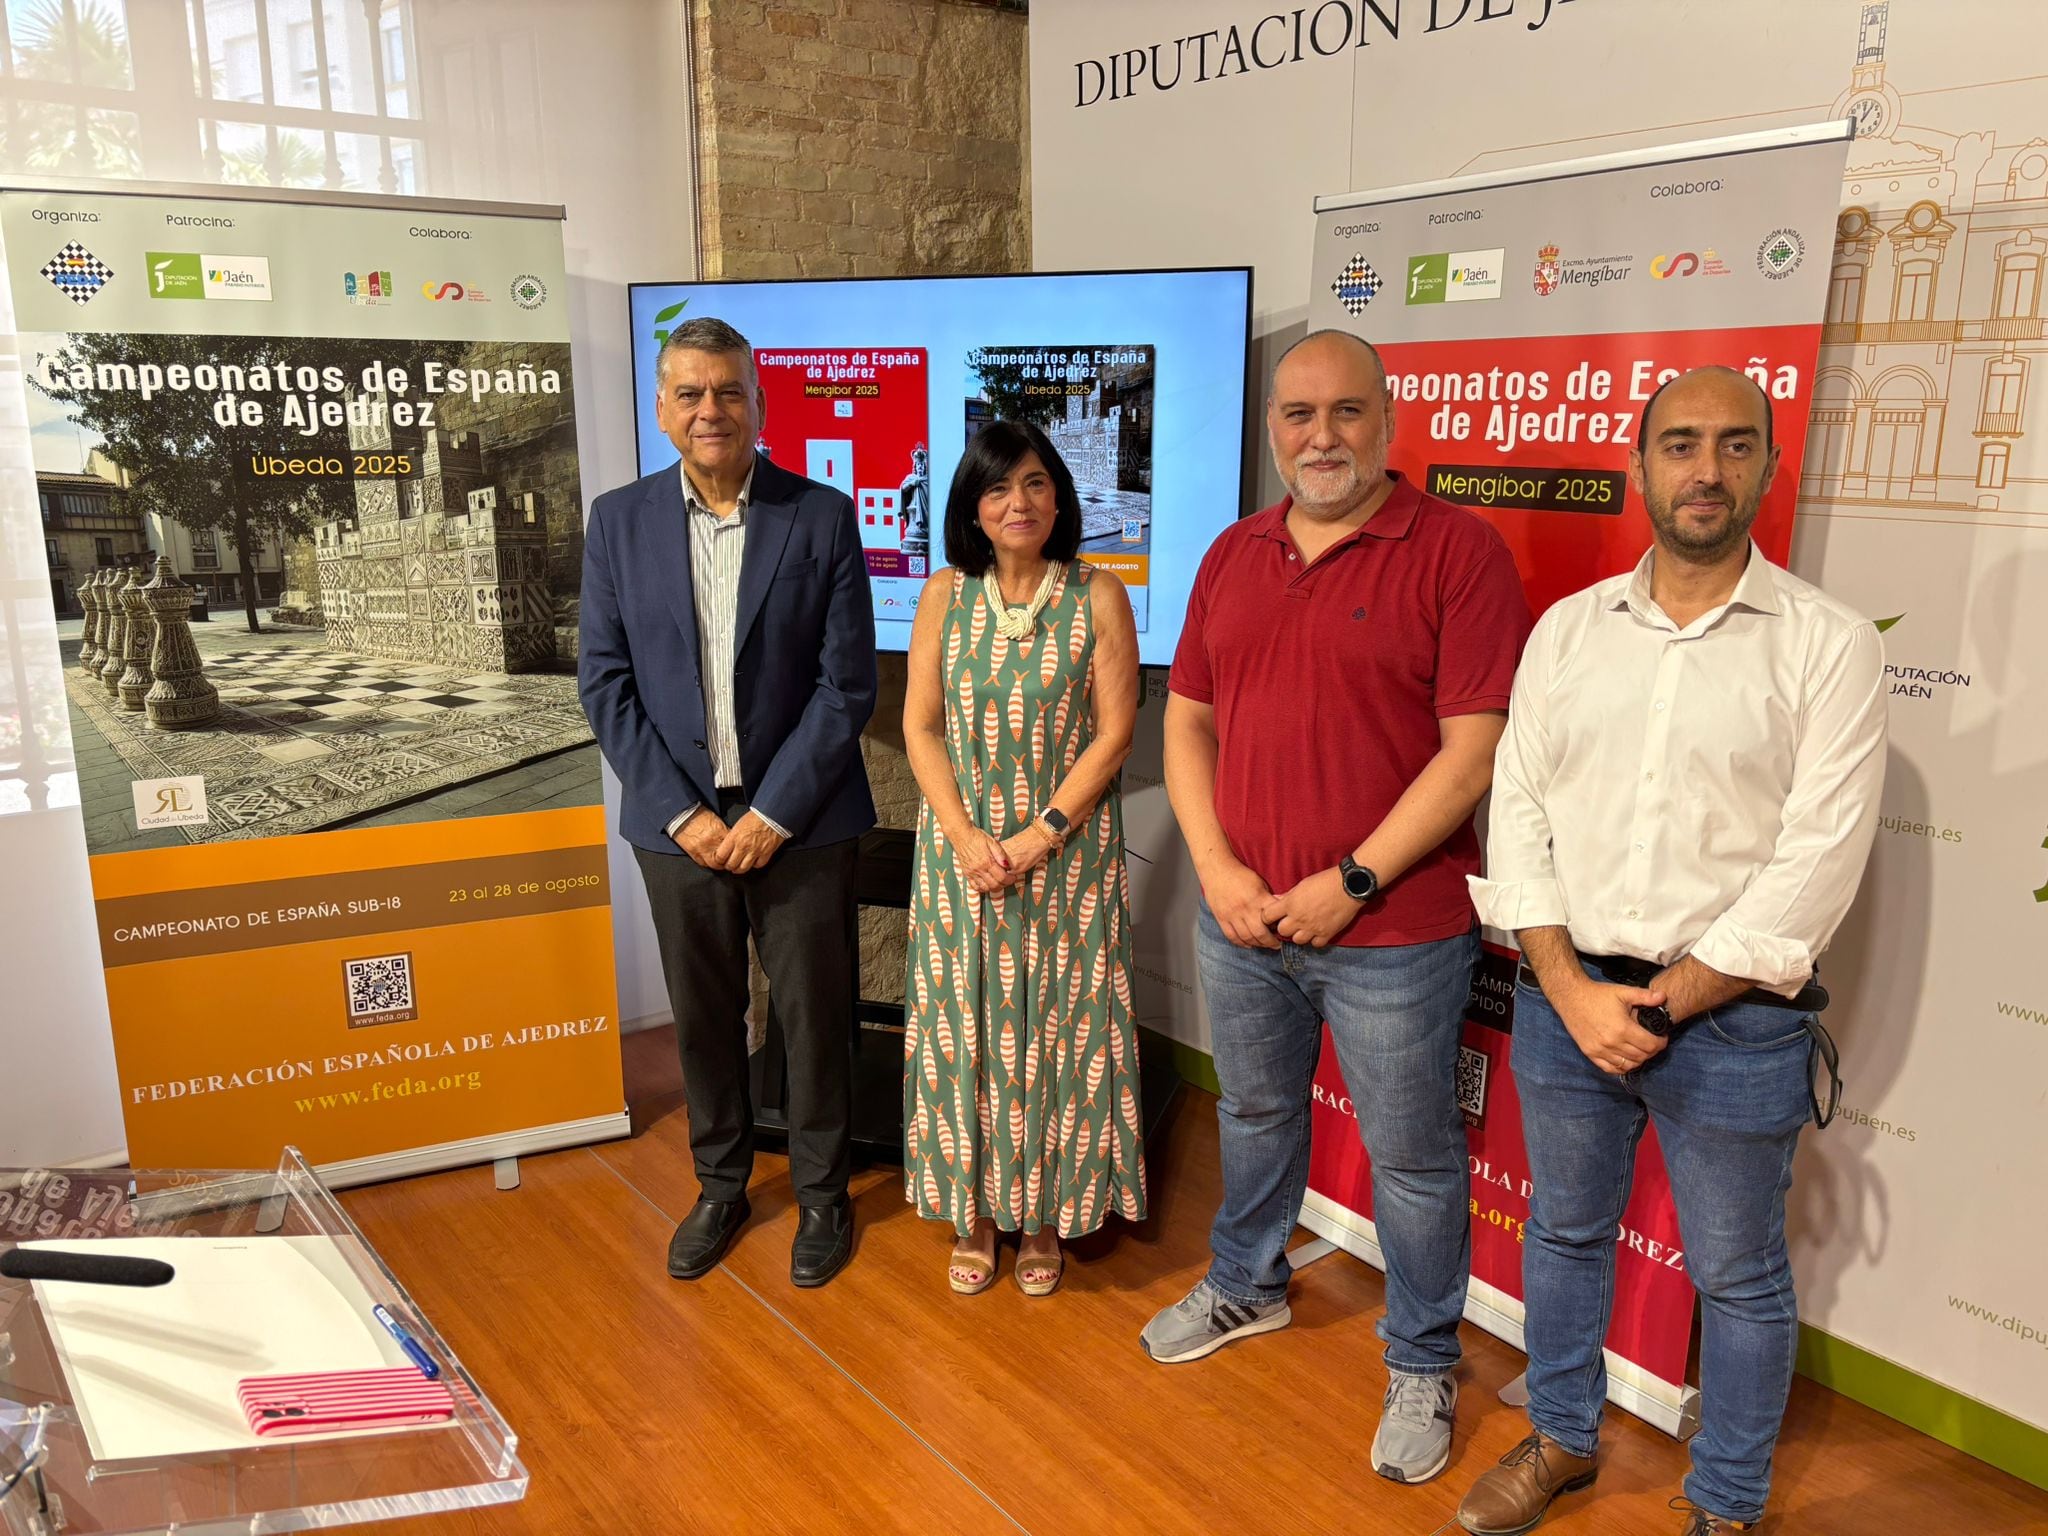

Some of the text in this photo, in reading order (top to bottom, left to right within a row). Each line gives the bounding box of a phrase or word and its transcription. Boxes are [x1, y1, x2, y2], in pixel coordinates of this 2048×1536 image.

[1650, 178, 1724, 199] Colabora:
[32, 209, 101, 224] Organiza:
[166, 214, 235, 228] Patrocina:
[1428, 209, 1484, 225] Patrocina:
[409, 227, 473, 240] Colabora:
[1334, 221, 1381, 239] Organiza:
[1586, 254, 1633, 266] Ayuntamiento
[223, 270, 254, 283] Jaén
[1463, 267, 1488, 281] Jaén
[1560, 265, 1631, 287] Mengíbar
[760, 352, 919, 369] Campeonatos de España
[971, 350, 1146, 368] Campeonatos de España
[38, 356, 561, 402] Campeonatos de España
[807, 365, 875, 382] de Ajedrez
[1022, 364, 1097, 381] de Ajedrez
[1386, 366, 1549, 402] peonatos
[1565, 361, 1611, 401] de
[855, 385, 879, 395] 2025
[1065, 385, 1091, 395] 2025
[213, 393, 436, 437] de Ajedrez
[1430, 403, 1633, 453] de Ajedrez
[252, 452, 412, 475] Úbeda 2025
[1436, 473, 1611, 504] Mengíbar 2025
[1885, 665, 1970, 687] PUTACIÓN
[1889, 683, 1932, 699] JAÉN
[449, 874, 600, 902] 23 al 28 de agosto
[114, 896, 402, 942] CAMPEONATO DE ESPAÑA SUB-18
[1471, 991, 1506, 1015] PIDO
[354, 1011, 410, 1026] www.feda.org
[132, 1015, 608, 1104] FEDERACIÓN ESPAÑOLA DE AJEDREZ
[294, 1071, 482, 1113] www.feda.org
[1948, 1295, 2048, 1350] www.dipu
